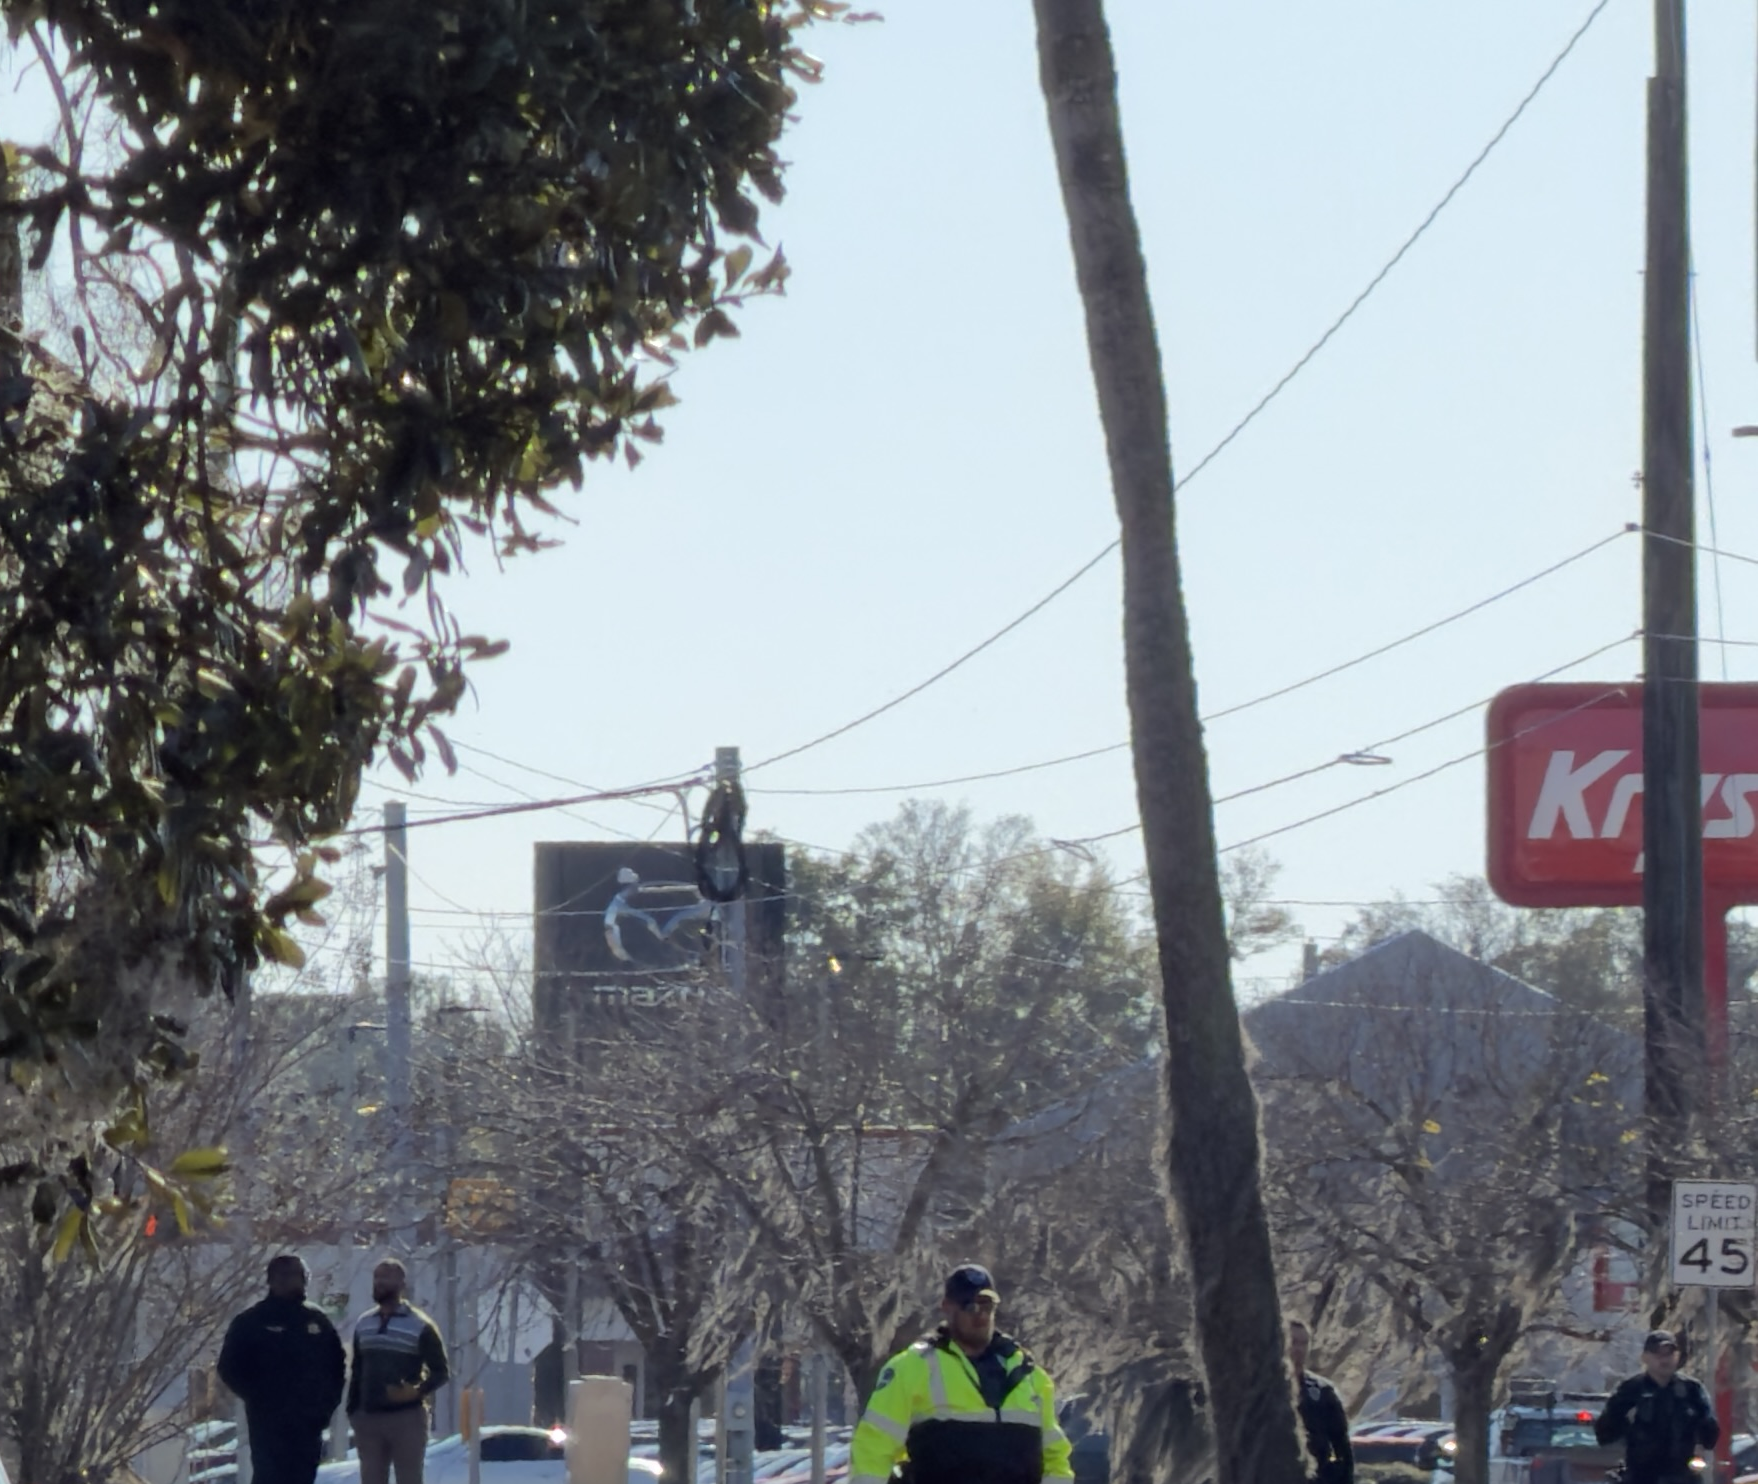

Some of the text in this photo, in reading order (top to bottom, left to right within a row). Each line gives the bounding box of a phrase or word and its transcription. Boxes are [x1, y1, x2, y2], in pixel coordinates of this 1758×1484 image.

[1527, 749, 1758, 874] Krs
[1681, 1193, 1751, 1210] SPEED
[1687, 1215, 1744, 1231] LIMIT
[1679, 1237, 1750, 1276] 45
